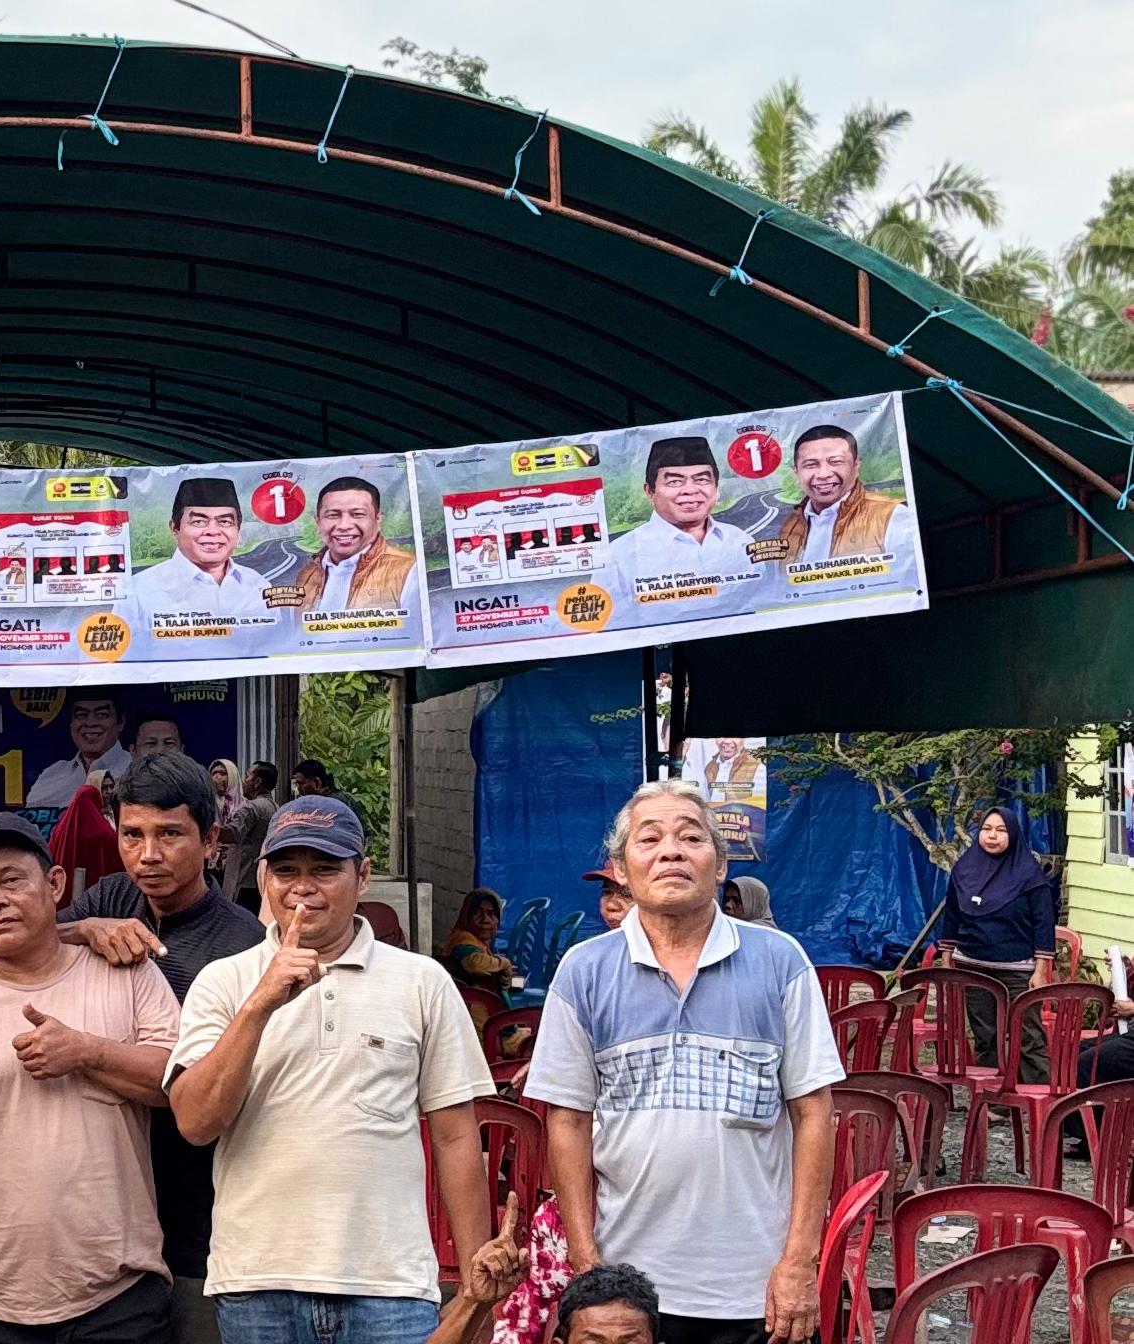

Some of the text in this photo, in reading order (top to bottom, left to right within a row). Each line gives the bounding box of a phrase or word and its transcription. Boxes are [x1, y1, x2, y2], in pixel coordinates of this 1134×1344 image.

[745, 439, 762, 471] 1
[270, 485, 285, 517] 1
[789, 564, 811, 573] ELDA
[794, 566, 883, 584] CALON WAKIL BUPATI
[636, 585, 646, 593] H.
[648, 580, 673, 591] RAJA
[676, 575, 723, 588] HARYONO,
[578, 586, 586, 595] #
[640, 589, 713, 603] CALON BUPATI
[455, 595, 518, 613] INGAT!
[564, 601, 605, 614] LEBIH
[305, 613, 327, 621] ELDA
[472, 611, 519, 621] NOVEMBER
[521, 609, 544, 617] 2024
[571, 613, 600, 623] BAIK
[154, 619, 163, 627] H.
[166, 618, 190, 627] RAJA
[192, 617, 239, 627] HARYONO,
[309, 620, 398, 631] CALON WAKIL BUPATI
[480, 621, 514, 630] NOMOR
[85, 631, 123, 643] LEBIH
[157, 630, 190, 638] CALON
[90, 642, 119, 652] BAIK
[173, 690, 226, 702] INHUKU
[26, 701, 50, 712] BAIK
